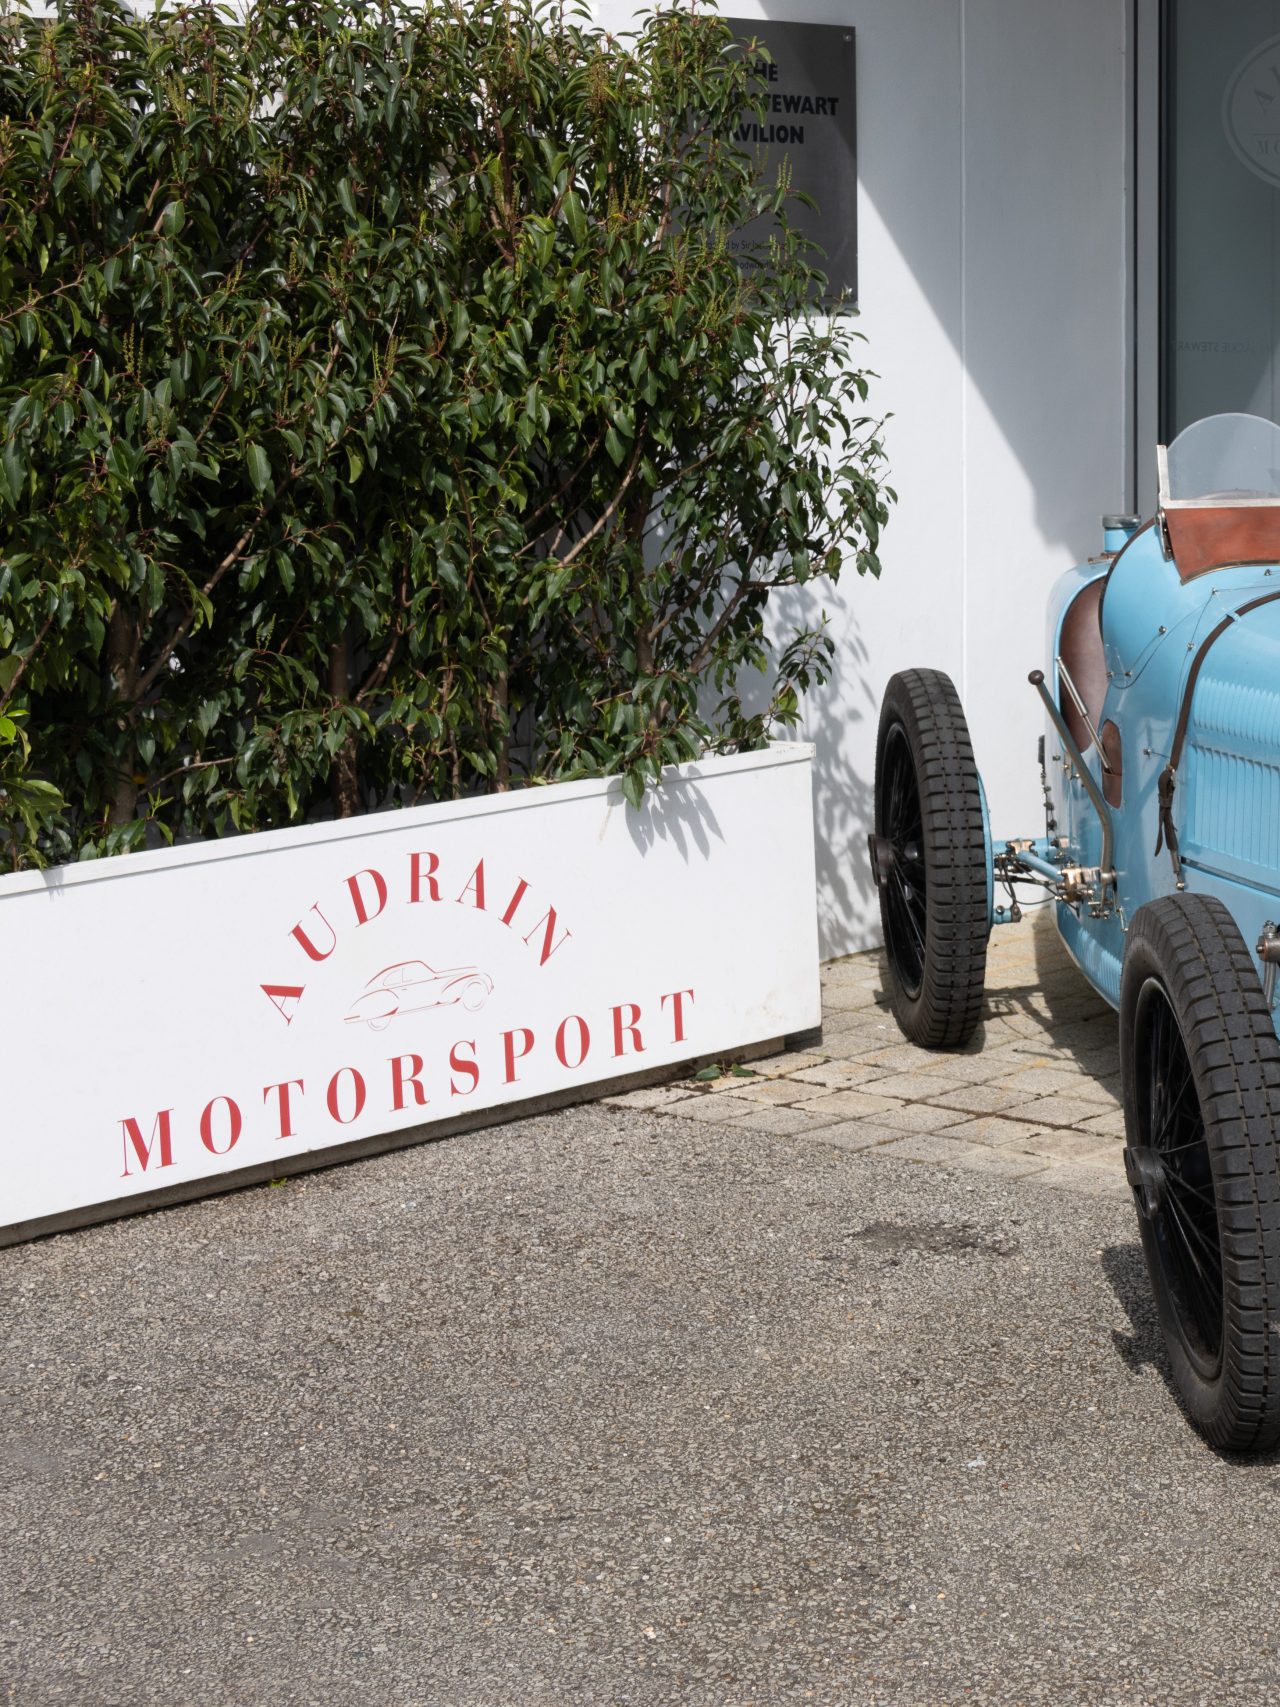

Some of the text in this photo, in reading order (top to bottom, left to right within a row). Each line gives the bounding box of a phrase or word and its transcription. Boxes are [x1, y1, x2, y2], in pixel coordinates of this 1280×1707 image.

[744, 61, 778, 82] HE
[732, 124, 804, 144] AVILION
[260, 851, 573, 1027] AUDRAIN
[117, 988, 695, 1178] MOTORSPORT
